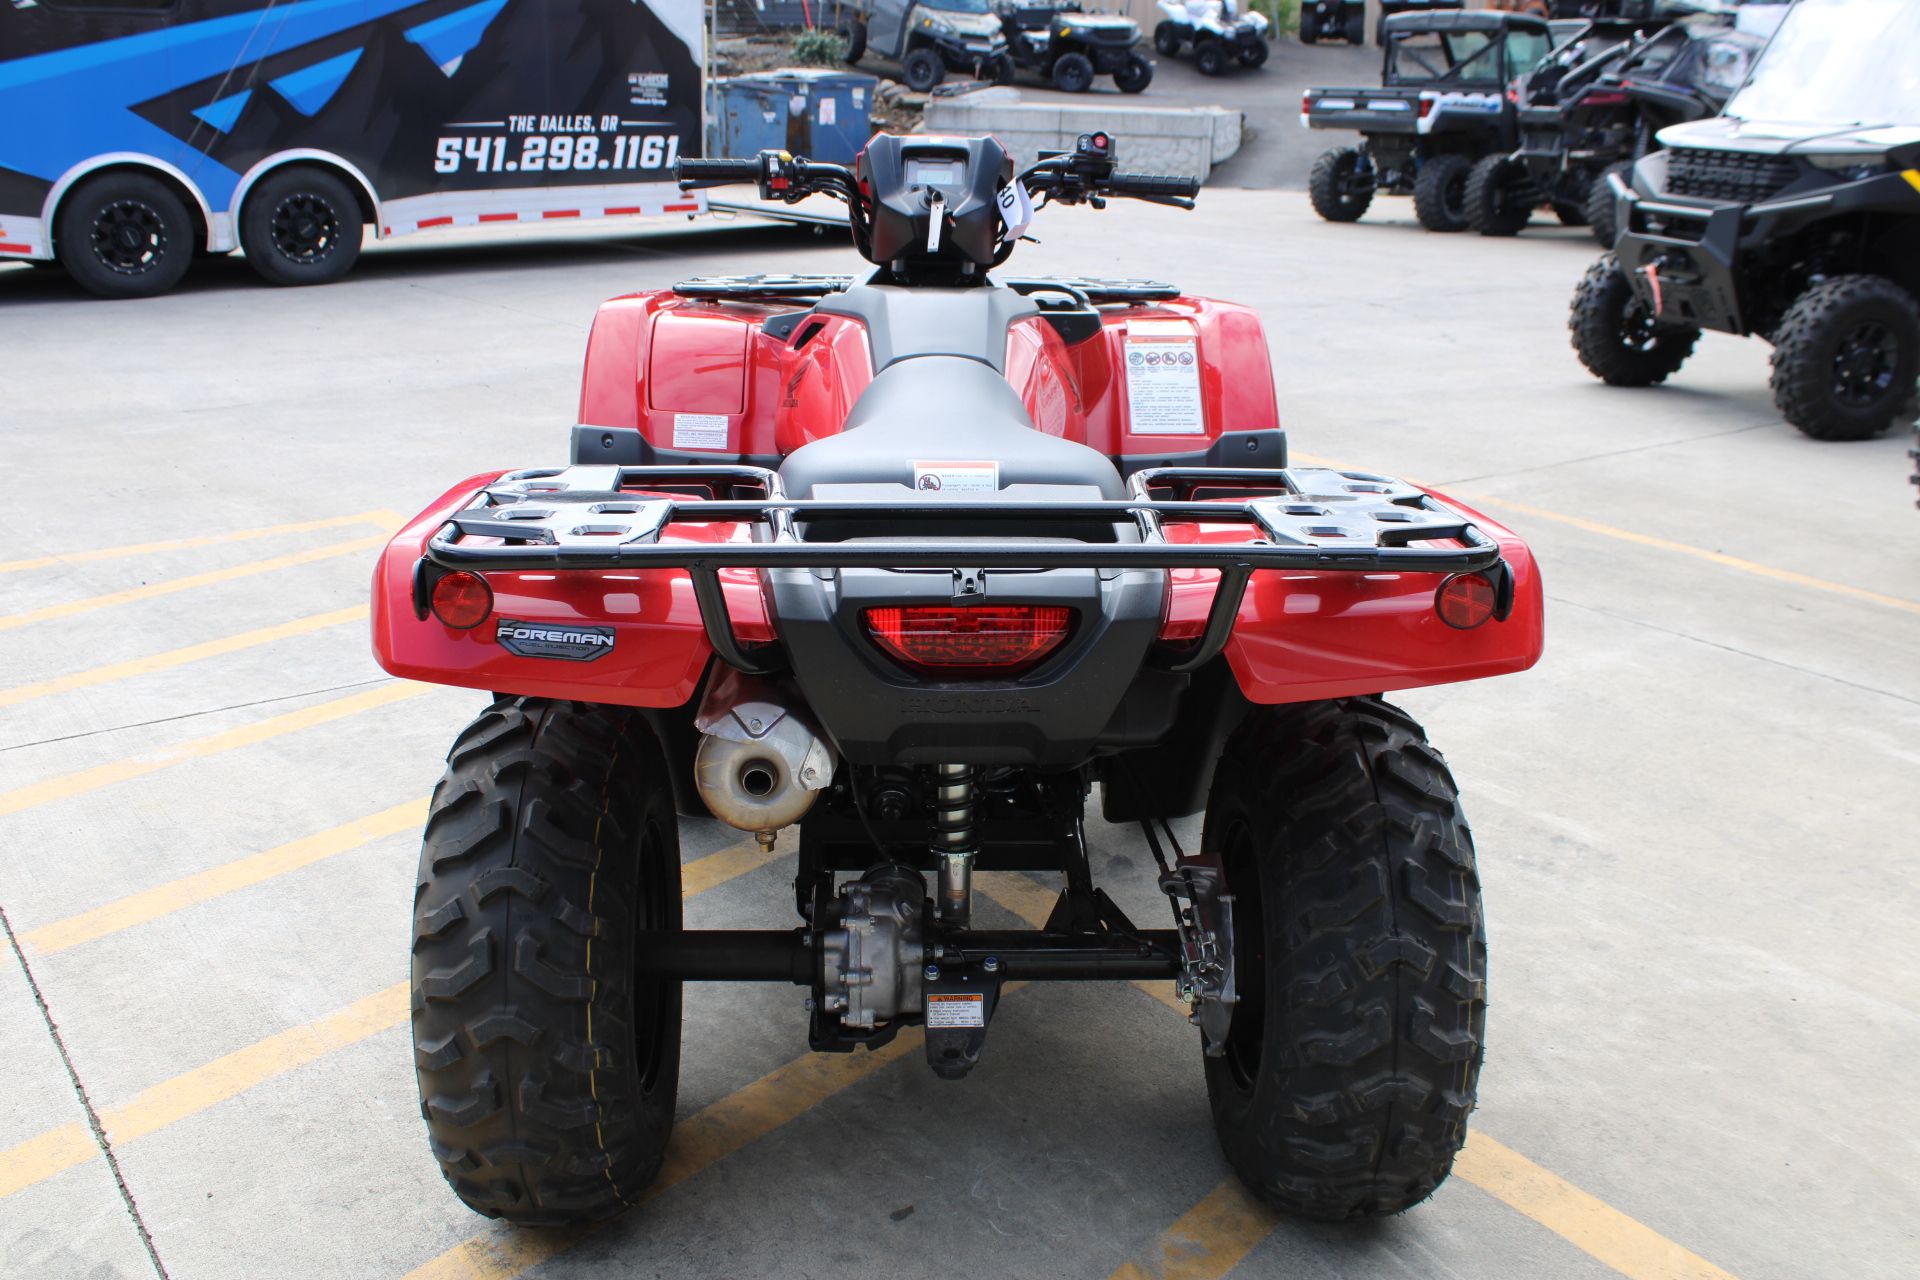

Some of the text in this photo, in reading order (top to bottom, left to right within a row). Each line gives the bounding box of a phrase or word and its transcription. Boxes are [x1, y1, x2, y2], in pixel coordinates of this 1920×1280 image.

[509, 115, 619, 133] THE DALLES, OR
[434, 135, 679, 173] 541.298.1161
[497, 627, 614, 647] FOREMAN
[900, 699, 1040, 713] HONDA
